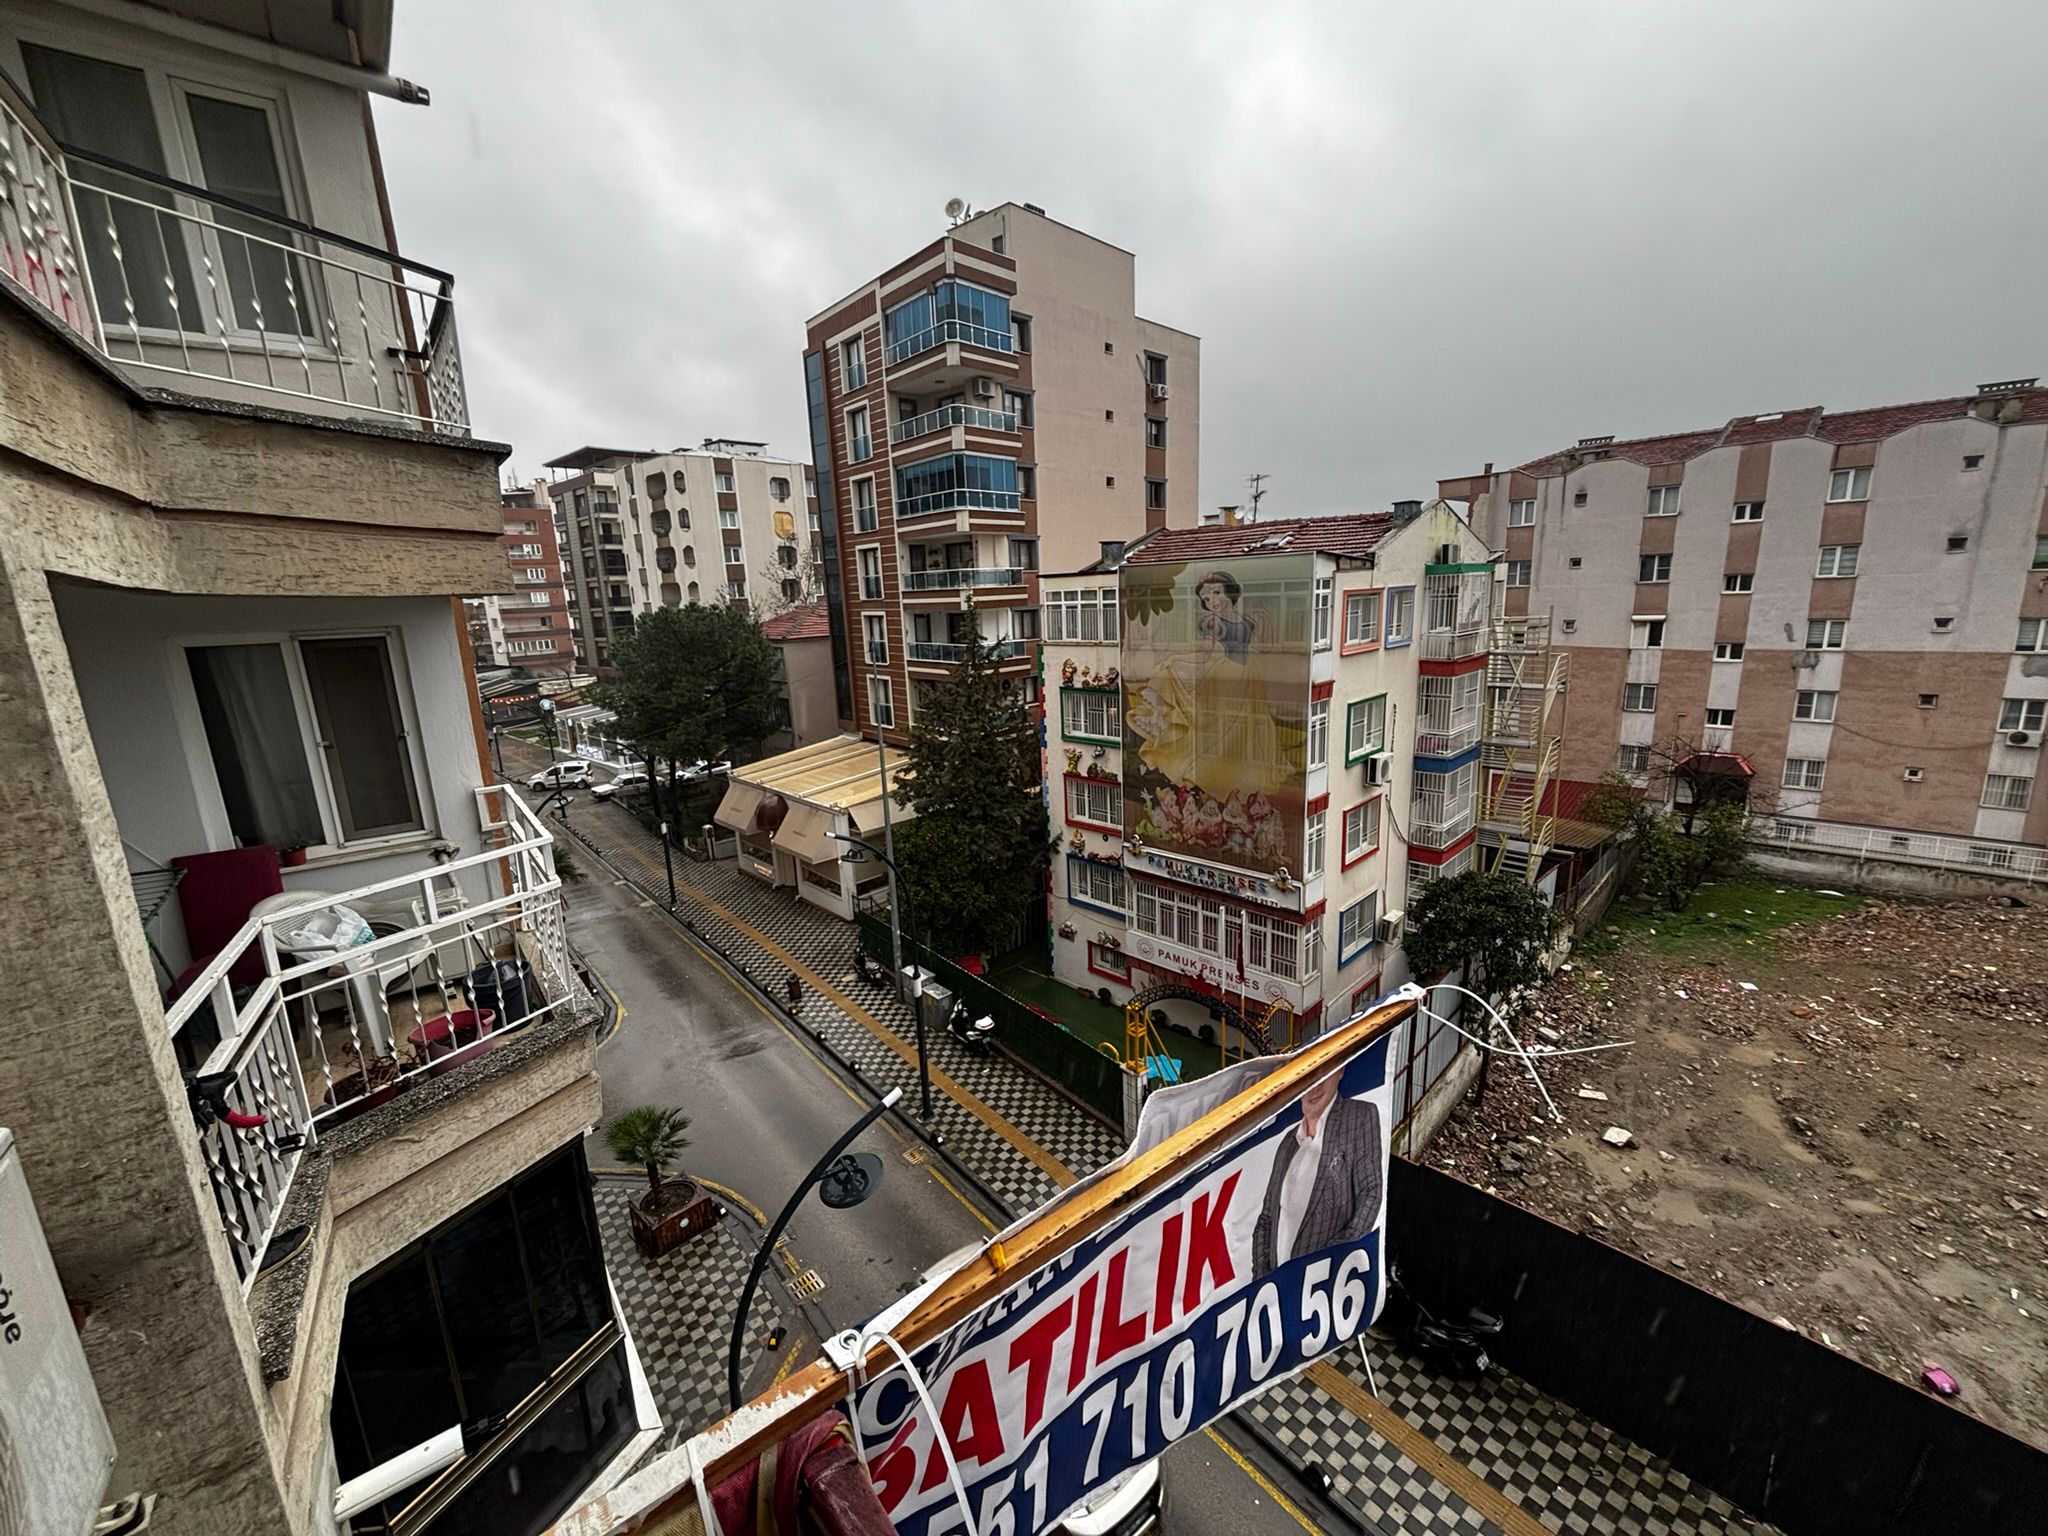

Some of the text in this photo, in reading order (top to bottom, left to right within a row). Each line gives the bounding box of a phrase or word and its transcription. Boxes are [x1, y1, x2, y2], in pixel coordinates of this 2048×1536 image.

[1149, 855, 1268, 893] PAMUK PRENSES
[1158, 949, 1197, 970] PAMUK
[1201, 962, 1260, 990] PRENSES
[1082, 1338, 1195, 1486] 710
[1216, 1281, 1284, 1406] 70
[1301, 1248, 1371, 1358] 56
